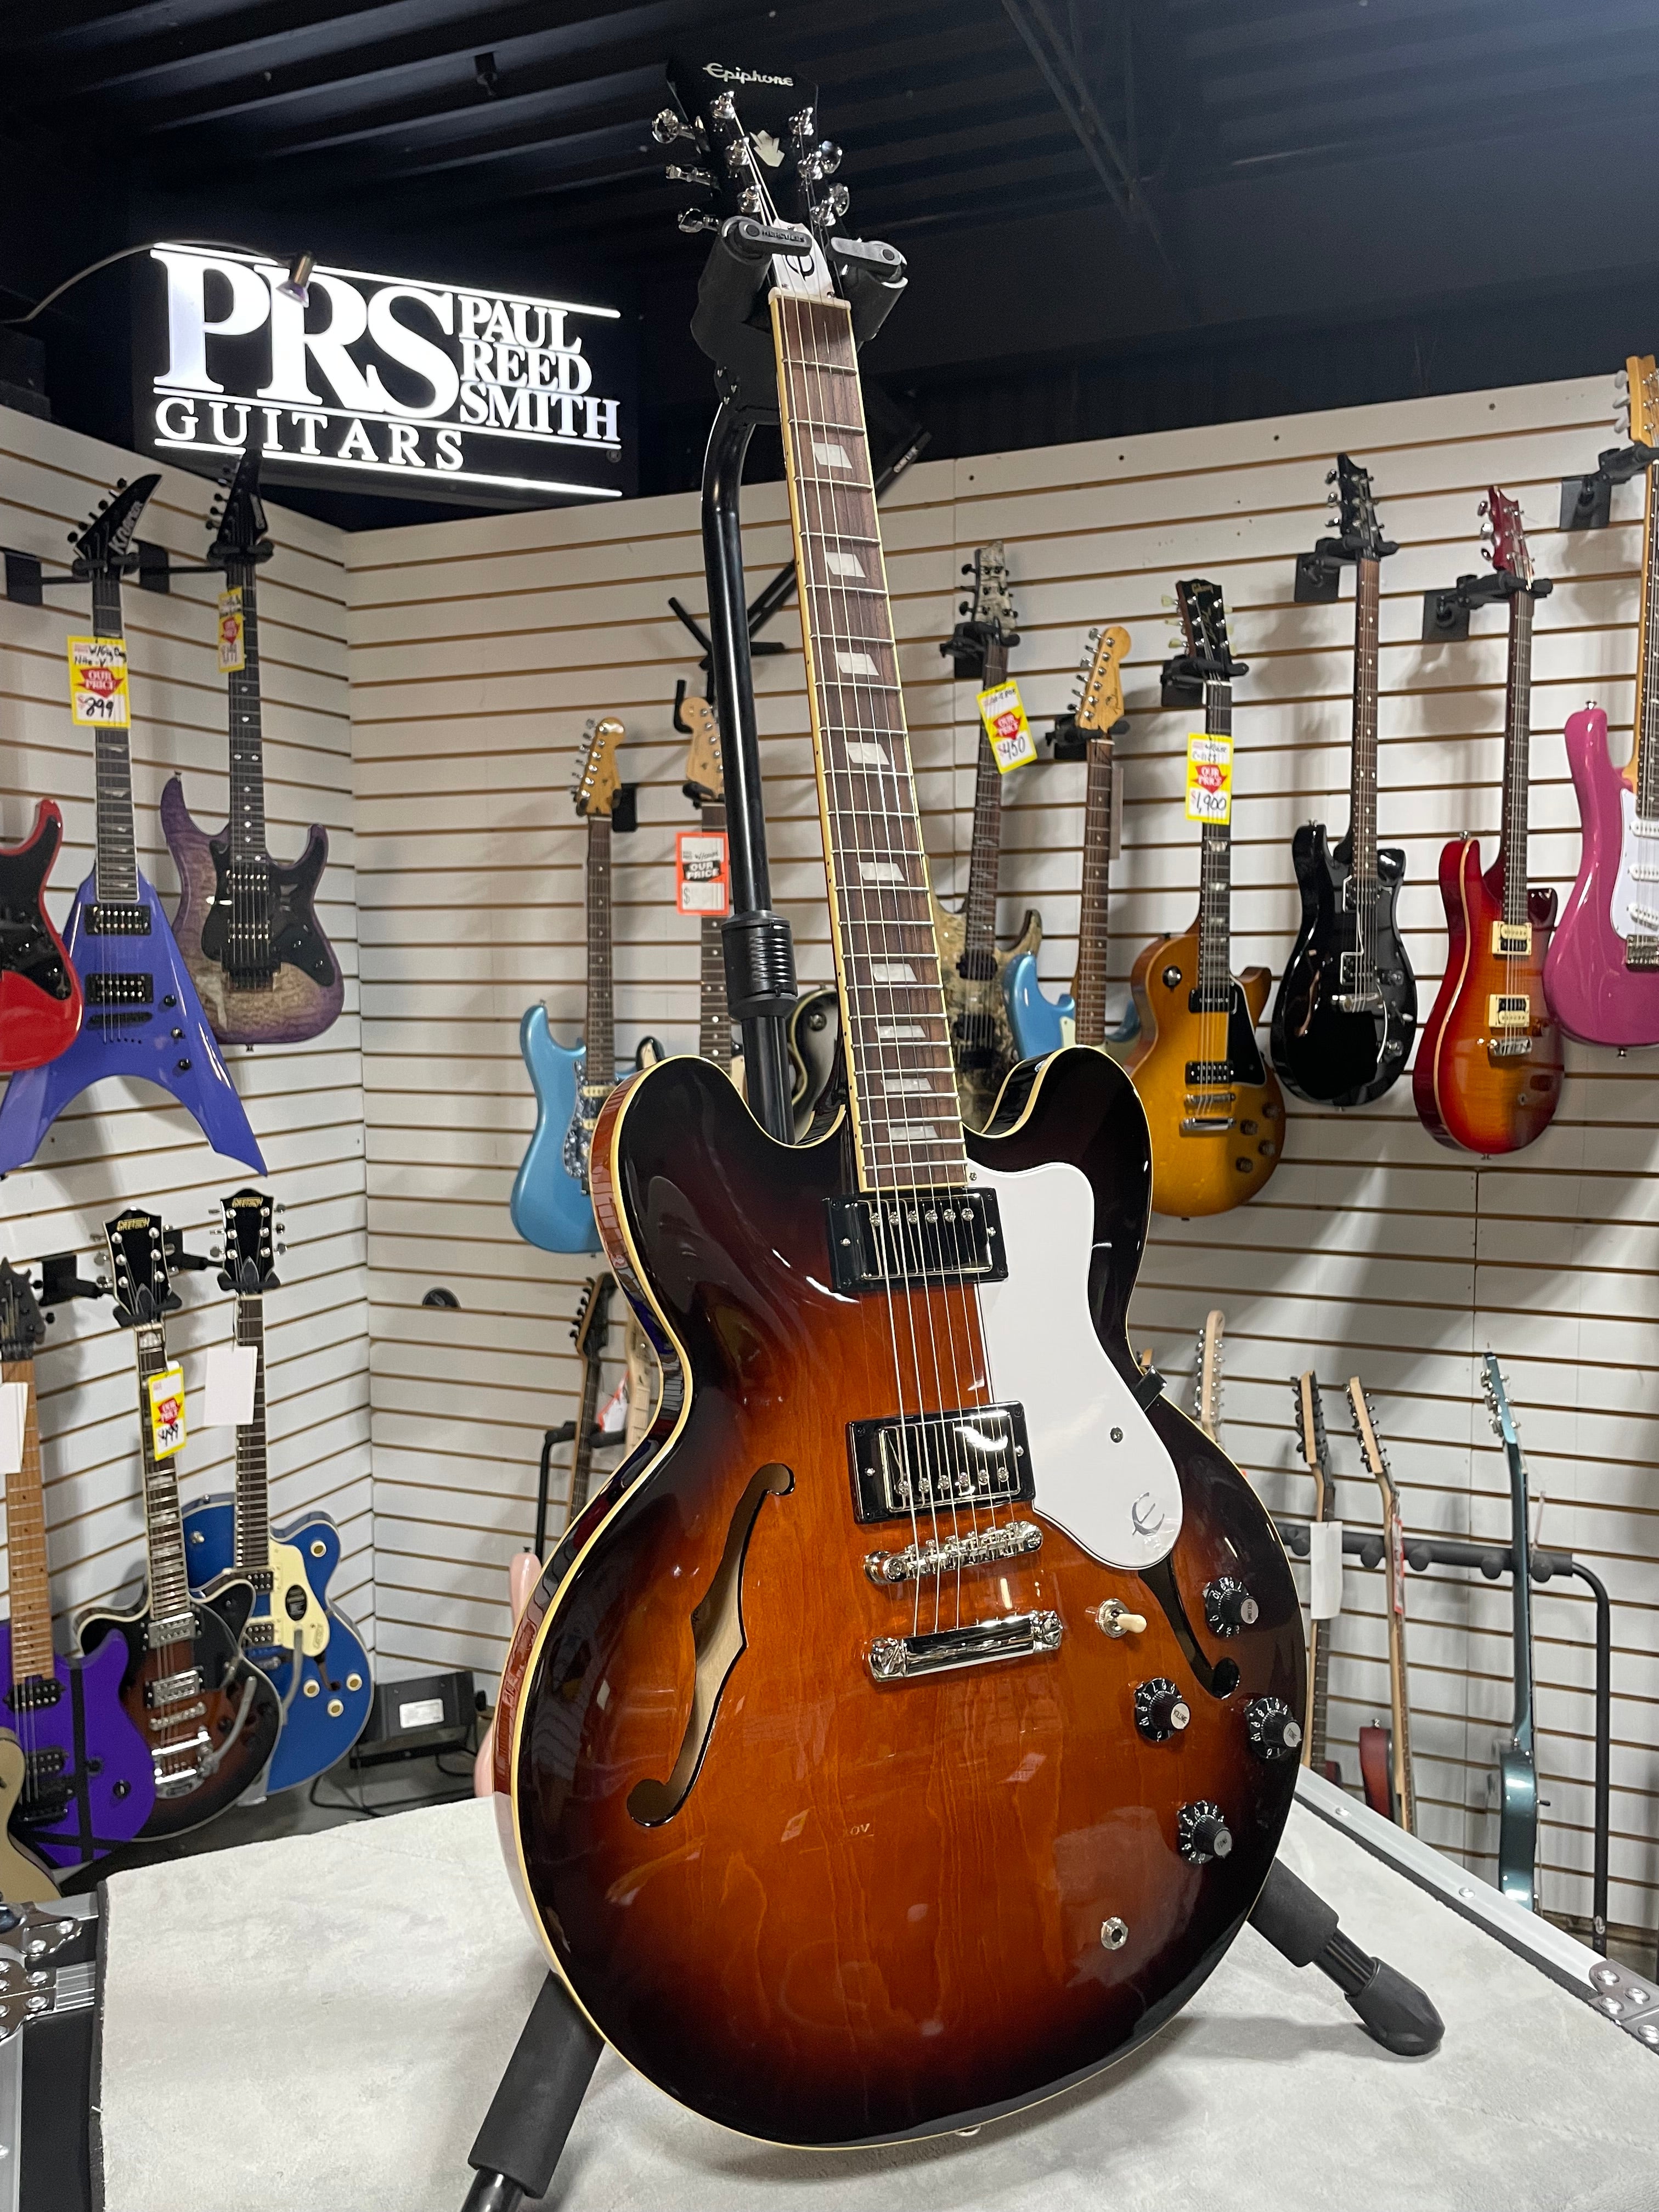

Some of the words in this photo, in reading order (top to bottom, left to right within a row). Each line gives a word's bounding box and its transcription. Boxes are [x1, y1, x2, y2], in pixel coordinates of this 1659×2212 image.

[702, 63, 794, 87] Epiphone
[151, 249, 460, 419] PRS
[458, 294, 582, 354] PAUL
[460, 337, 592, 394] REED
[155, 397, 463, 471] GUITARS
[459, 381, 621, 441] SMITH
[88, 670, 112, 681] OUR
[687, 868, 720, 880] PRICE
[690, 861, 713, 871] OUR
